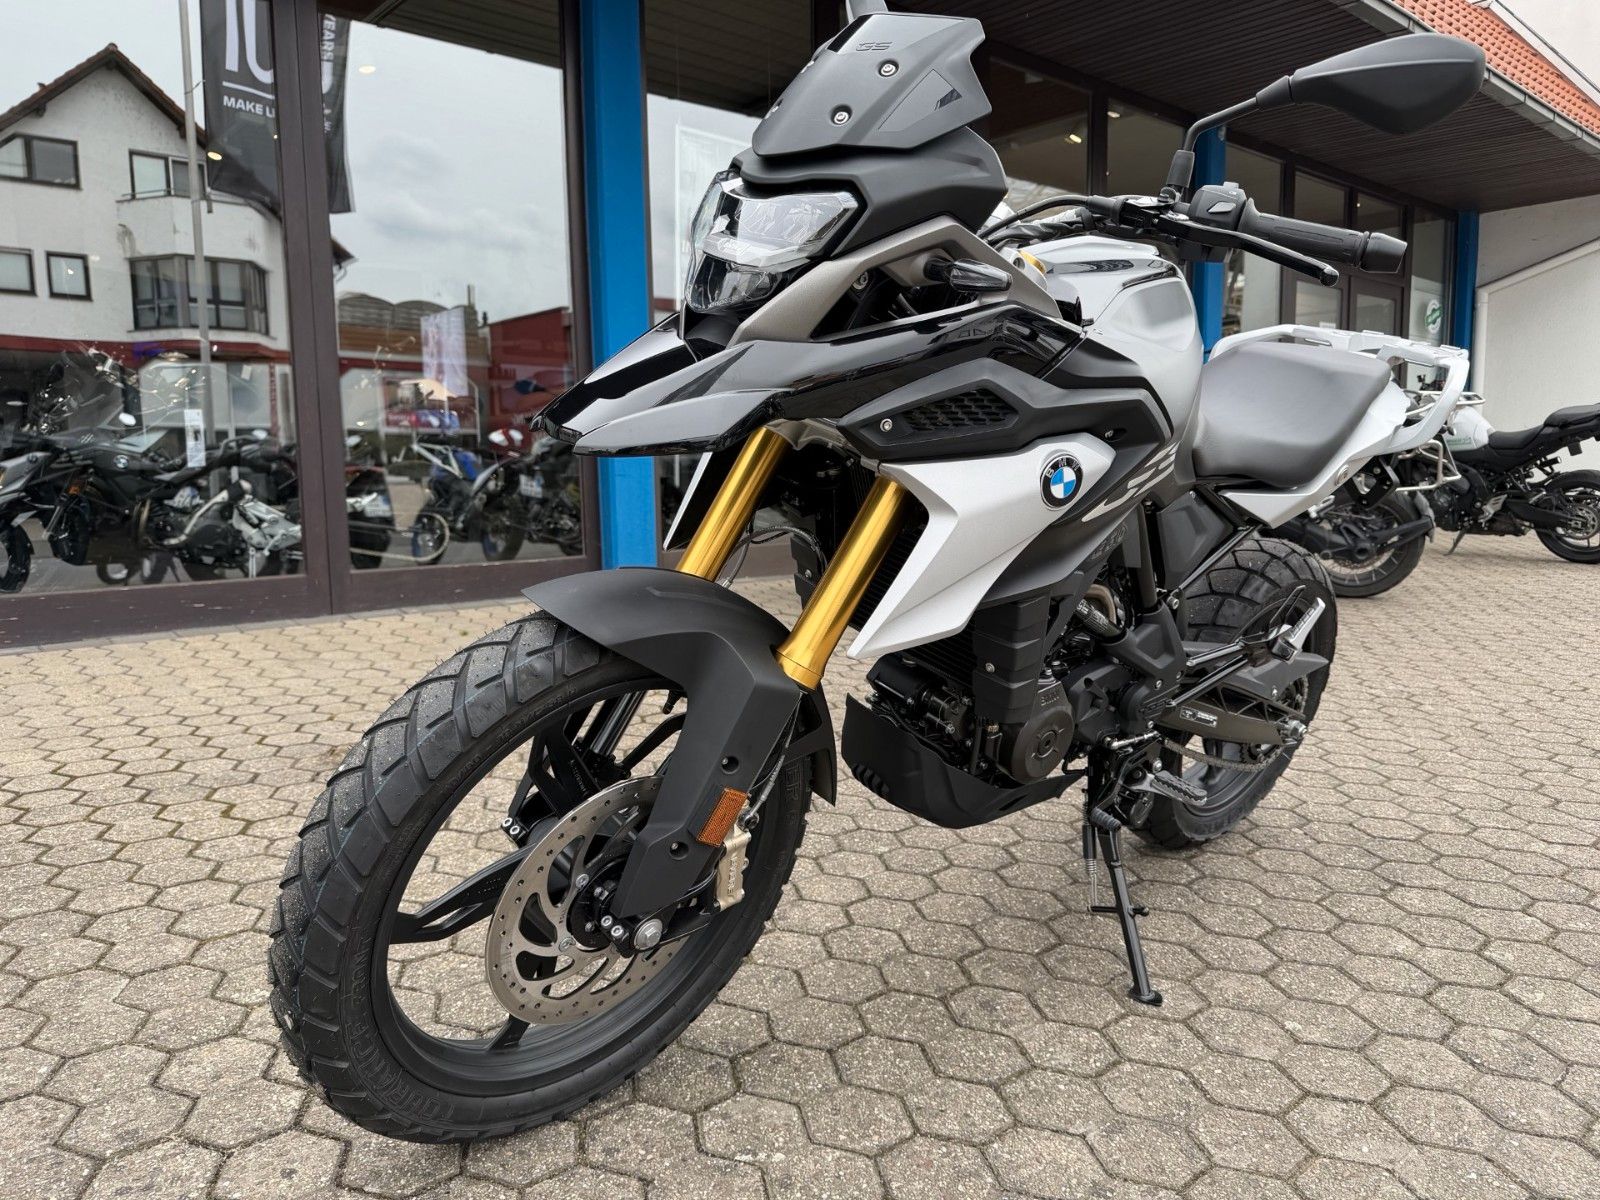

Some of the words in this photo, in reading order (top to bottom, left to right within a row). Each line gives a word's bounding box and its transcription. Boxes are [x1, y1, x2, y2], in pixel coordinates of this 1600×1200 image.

[856, 41, 893, 52] GS
[223, 95, 264, 115] MAKE
[1045, 456, 1081, 478] BMW
